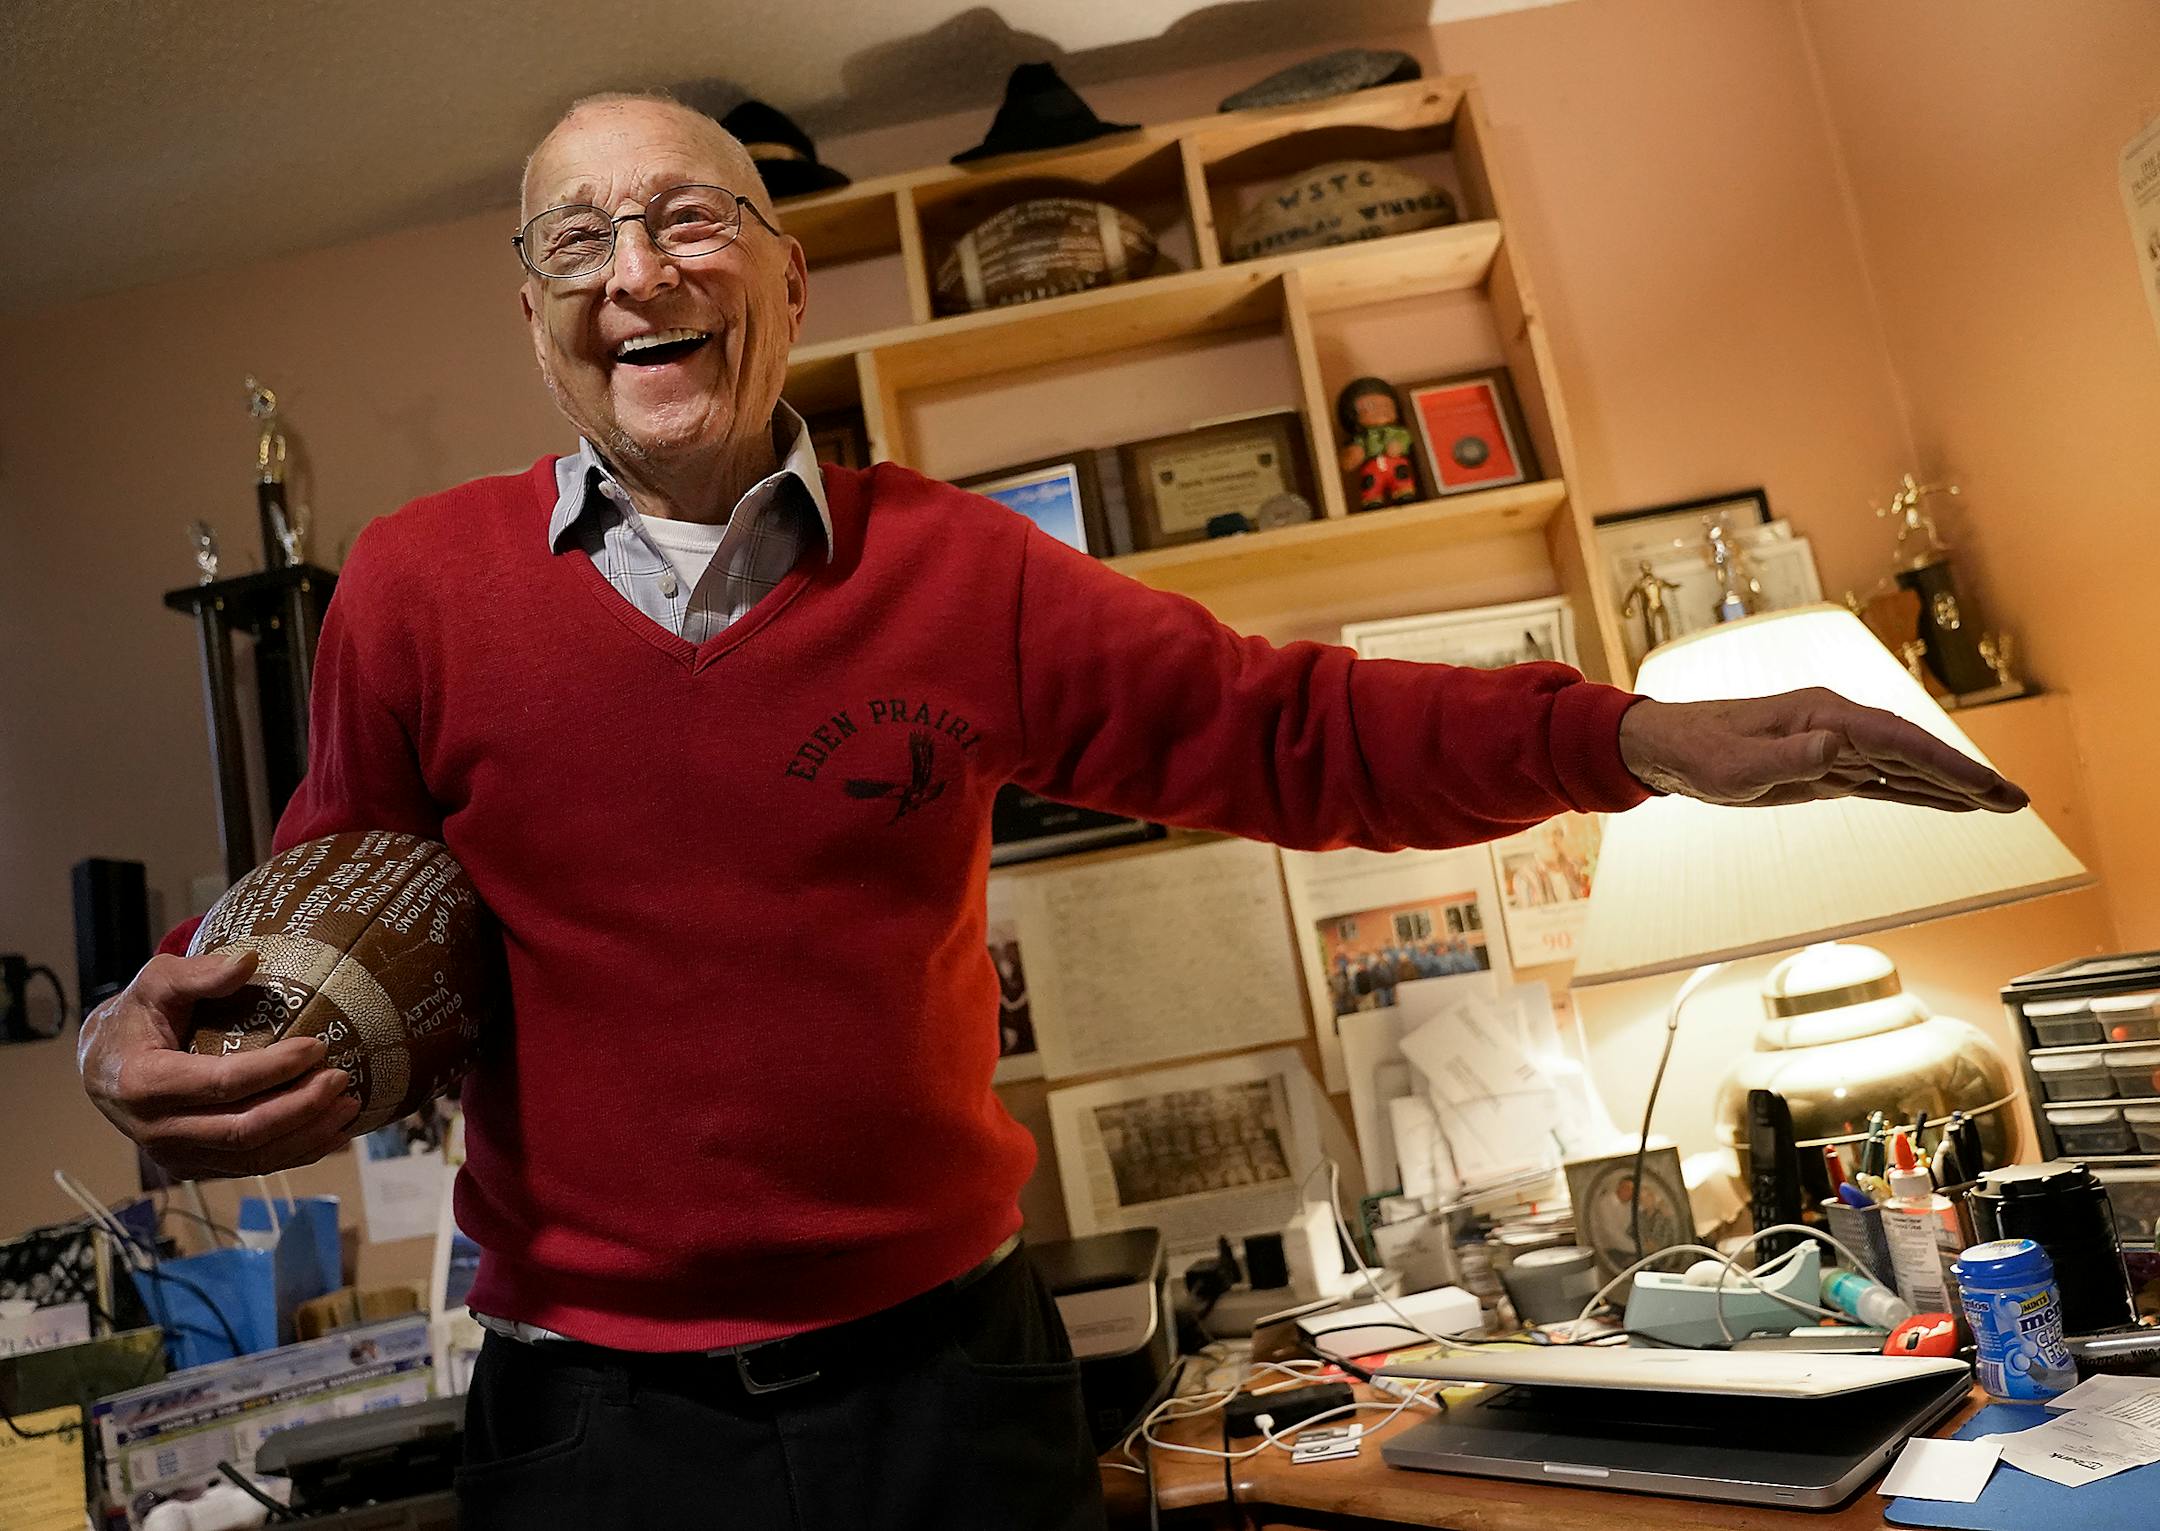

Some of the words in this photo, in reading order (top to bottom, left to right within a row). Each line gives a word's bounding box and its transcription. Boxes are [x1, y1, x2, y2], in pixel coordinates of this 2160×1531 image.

[784, 710, 858, 782] EDEN
[868, 698, 982, 750] PRAIRI
[256, 871, 286, 900] JOHN
[334, 885, 372, 913] YORE
[355, 883, 393, 916] RYSKI
[281, 884, 330, 934] REDDICK
[292, 893, 338, 939] ZIEGLER
[428, 903, 450, 945] 1968
[267, 986, 308, 1036] 1967
[403, 986, 450, 1027] VALLEY
[412, 992, 463, 1039] GOLDEN
[2021, 1292, 2050, 1313] MINTS
